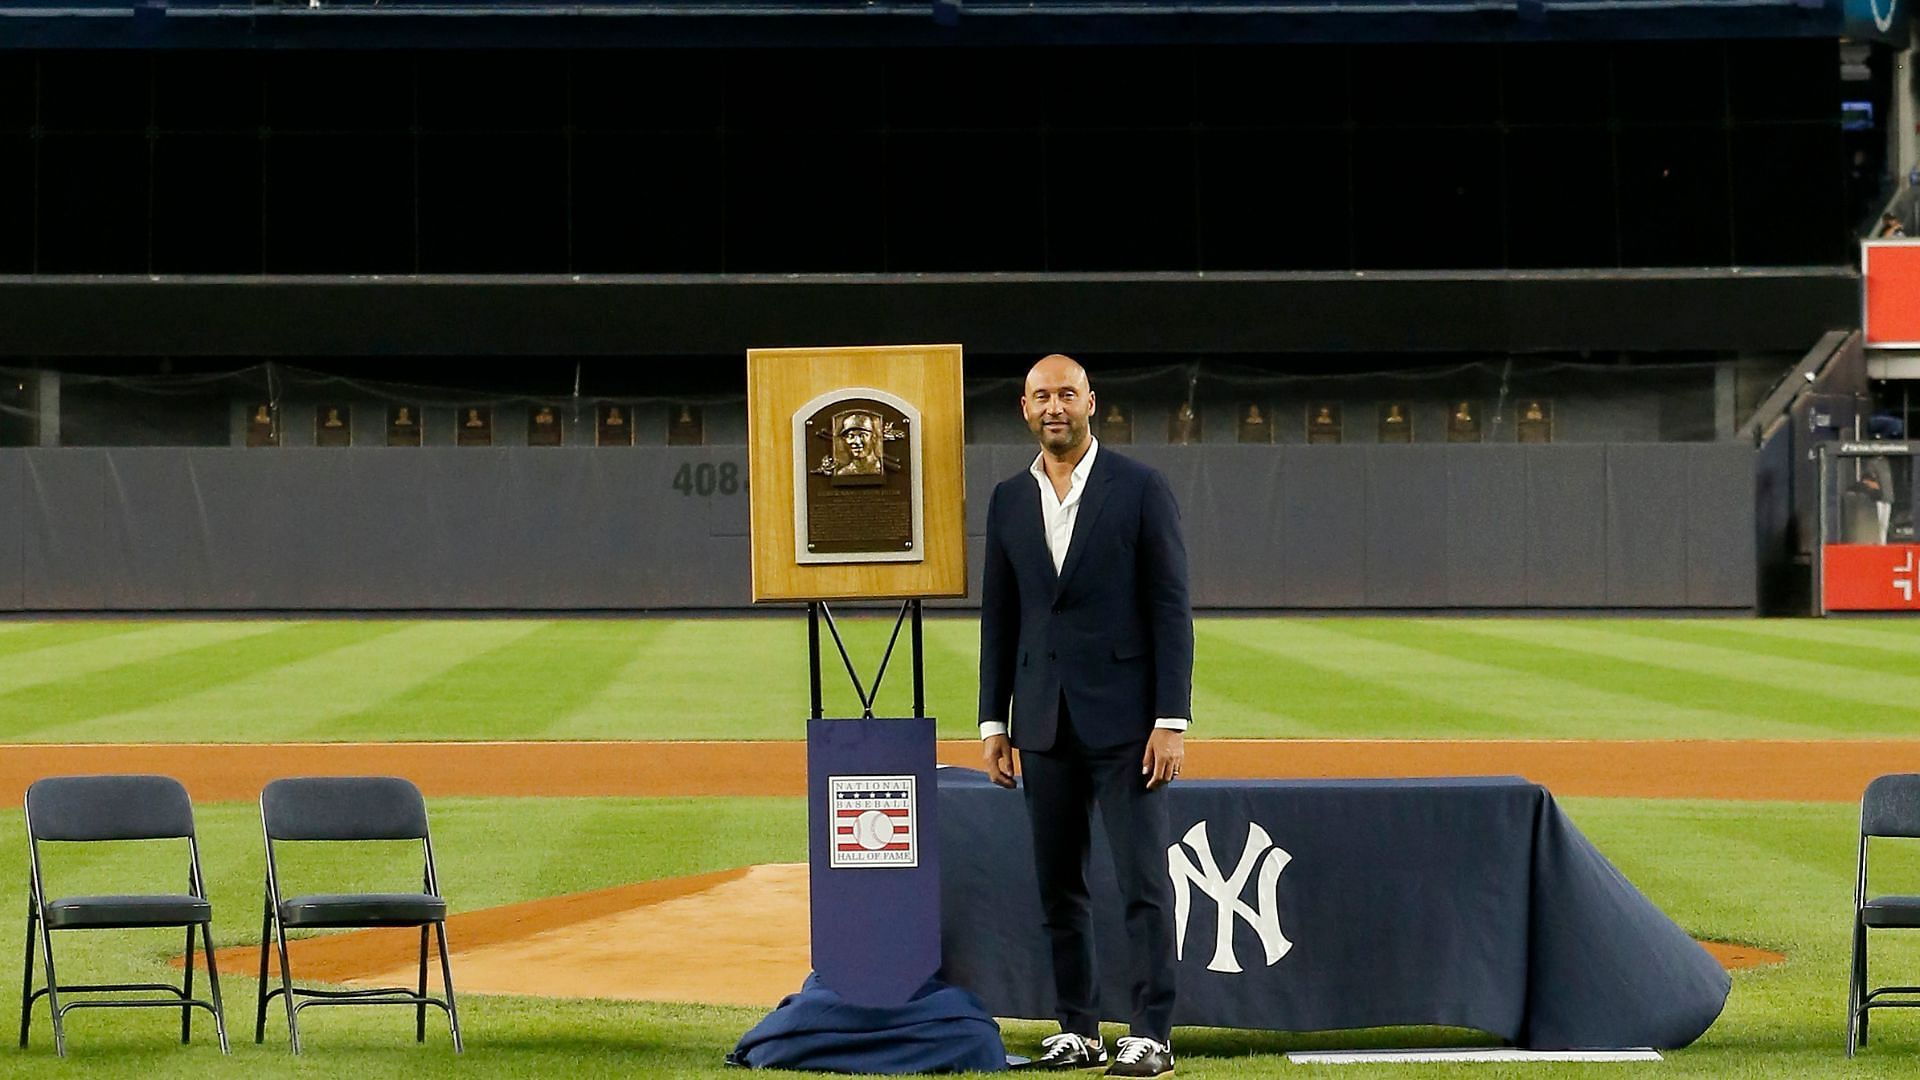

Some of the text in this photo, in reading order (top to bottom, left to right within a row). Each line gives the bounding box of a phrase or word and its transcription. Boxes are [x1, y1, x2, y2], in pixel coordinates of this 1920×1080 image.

[672, 462, 739, 496] 408
[836, 782, 909, 790] NATIONAL
[836, 800, 909, 808] BASEBALL
[837, 853, 865, 861] HALL
[883, 852, 911, 860] FAME
[1167, 820, 1293, 973] NY
